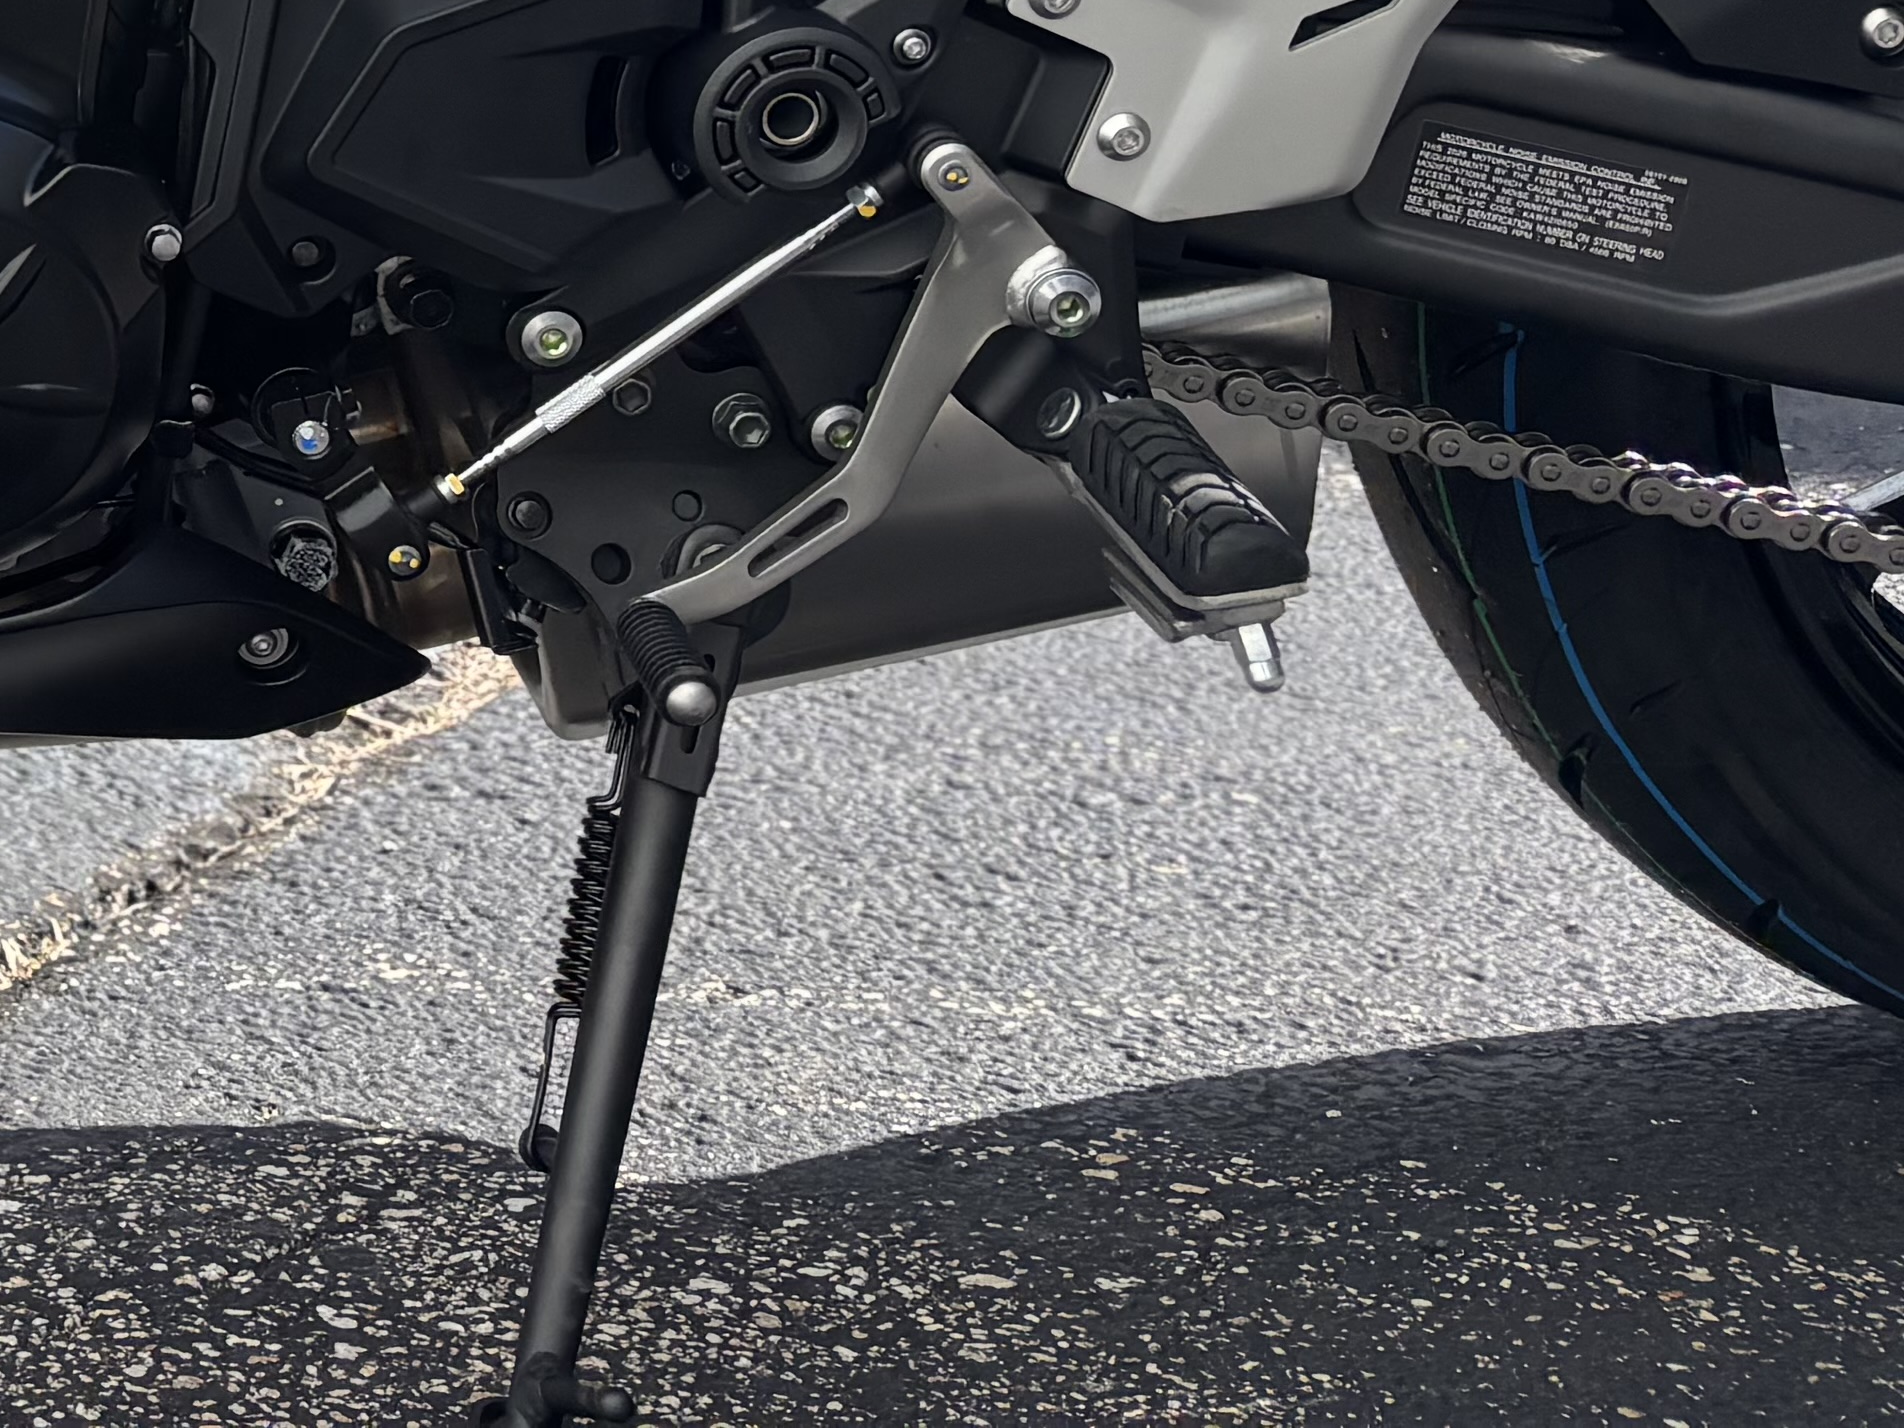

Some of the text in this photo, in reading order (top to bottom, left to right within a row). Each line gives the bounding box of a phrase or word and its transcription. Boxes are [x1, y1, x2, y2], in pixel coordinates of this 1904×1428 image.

[1418, 150, 1490, 173] REQUIREMENTS
[1493, 166, 1507, 176] BY
[1511, 170, 1530, 181] THE
[1533, 175, 1576, 191] FEDERAL
[1580, 185, 1603, 197] TEST
[1421, 141, 1442, 153] THIS
[1470, 152, 1534, 172] MOTORCYCLE
[1537, 167, 1569, 180] MEETS
[1573, 174, 1593, 185] EPA
[1596, 179, 1625, 192] NOISE
[1629, 186, 1675, 203] EMISSION
[1440, 131, 1505, 152] MOTORCYCLE
[1508, 146, 1537, 159] NOISE
[1541, 153, 1587, 169] EMISSION
[1590, 164, 1634, 179] CONTROL
[1408, 184, 1440, 199] MODEL
[1444, 192, 1486, 208] SPECIFIC
[1410, 176, 1422, 186] BY
[1424, 179, 1464, 195] FEDERAL
[1494, 194, 1513, 205] SEE
[1413, 167, 1673, 231] EXCEED FEDERAL NOISE STANDARDS ARE PROHIBITED
[1415, 159, 1668, 220] MODIFICATIONS WHICH CAUSE THIS MOTORCYCLE TO
[1403, 204, 1432, 217] NOISE
[1510, 227, 1533, 239] RPM
[1613, 249, 1635, 261] RPM
[1405, 194, 1665, 259] SEE VEHICLE IDENTIFICATION NUMBER ON STEERING HEAD
